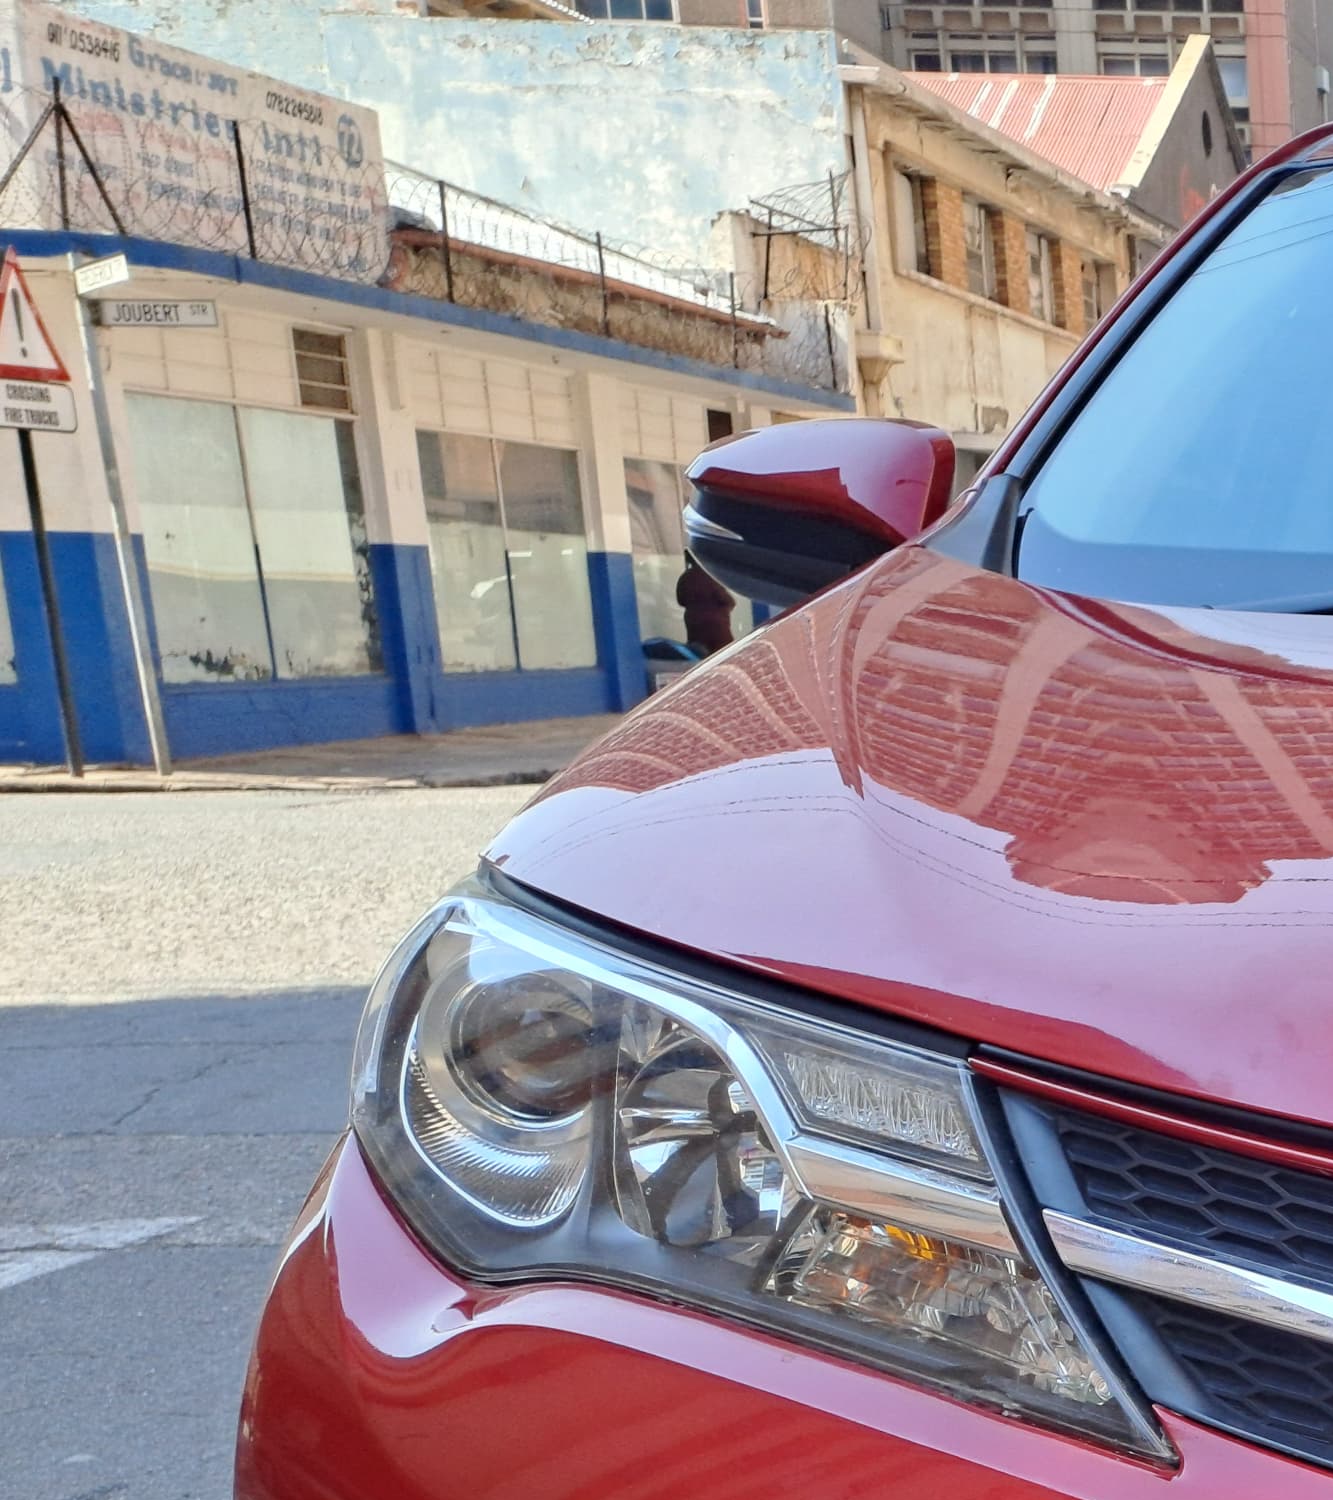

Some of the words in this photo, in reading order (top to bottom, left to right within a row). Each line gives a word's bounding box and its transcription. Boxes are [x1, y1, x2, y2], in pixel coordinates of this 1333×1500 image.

[113, 303, 181, 323] JOUBERT
[189, 304, 208, 317] STR
[4, 407, 24, 424] FIRE
[24, 408, 60, 427] TRUCKS
